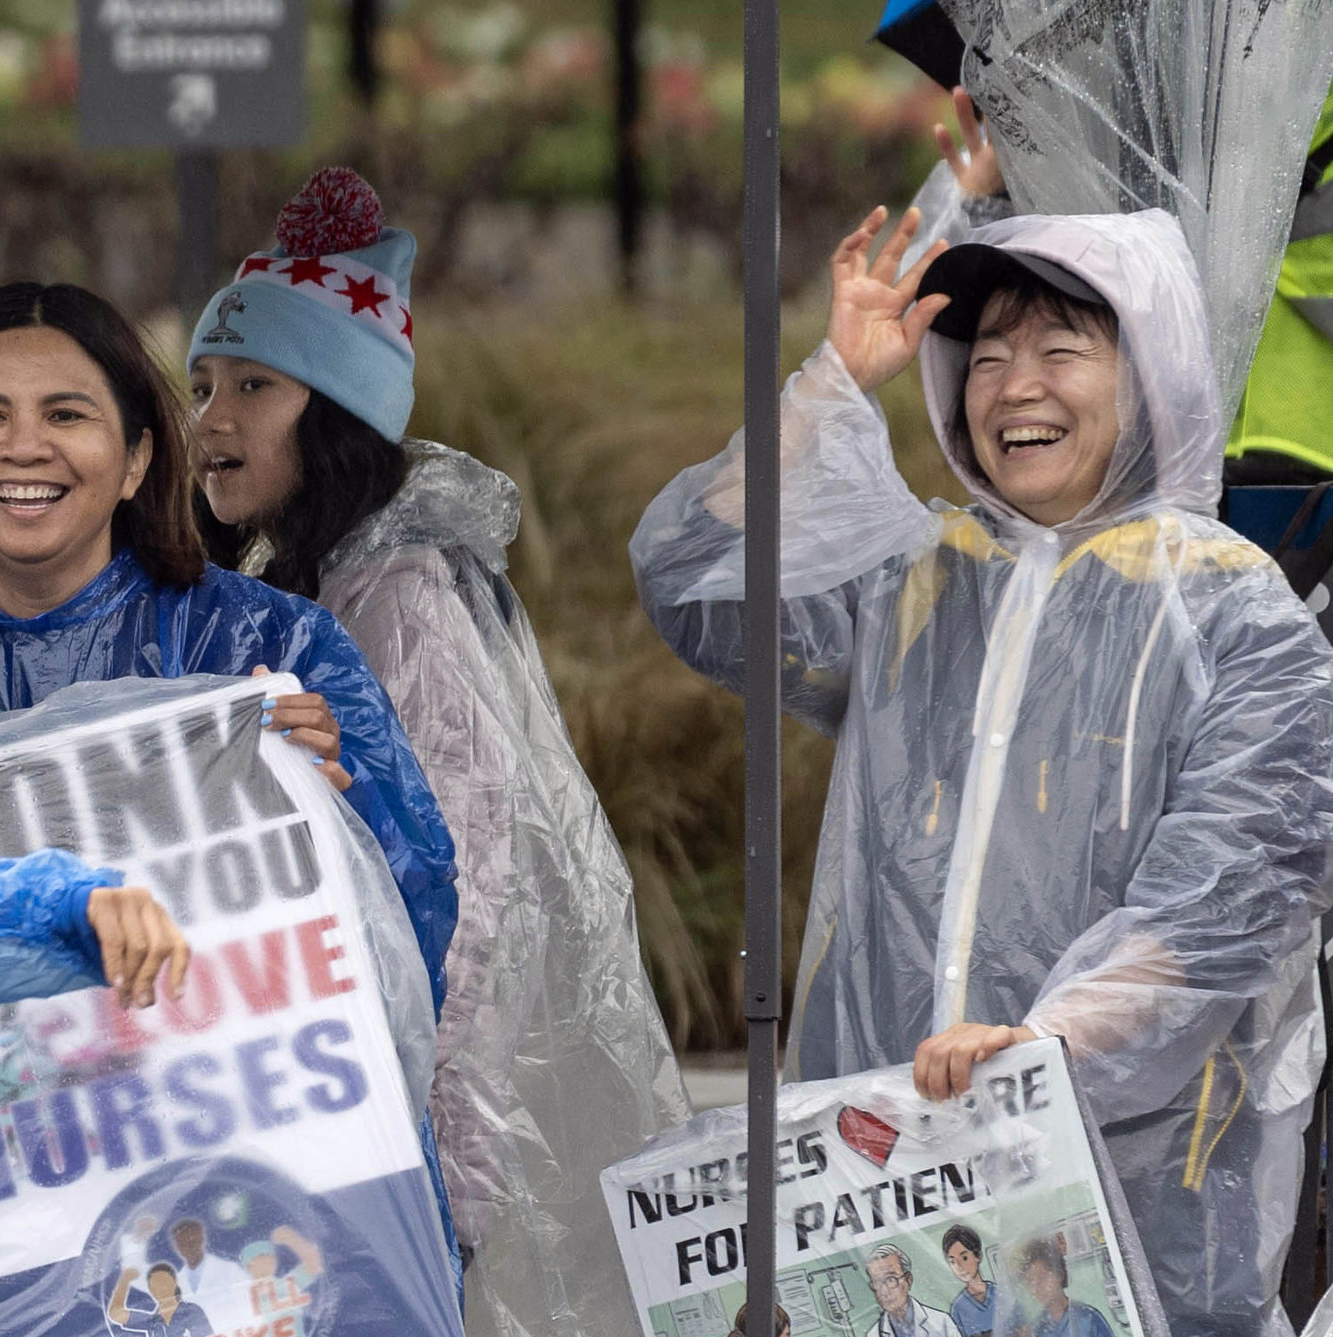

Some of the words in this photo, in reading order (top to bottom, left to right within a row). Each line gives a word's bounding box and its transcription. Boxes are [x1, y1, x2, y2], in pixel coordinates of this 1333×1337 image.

[145, 820, 323, 927] YOU
[108, 914, 356, 1047] LOVE
[676, 1222, 748, 1285] FO
[794, 1154, 995, 1251] PATIEN
